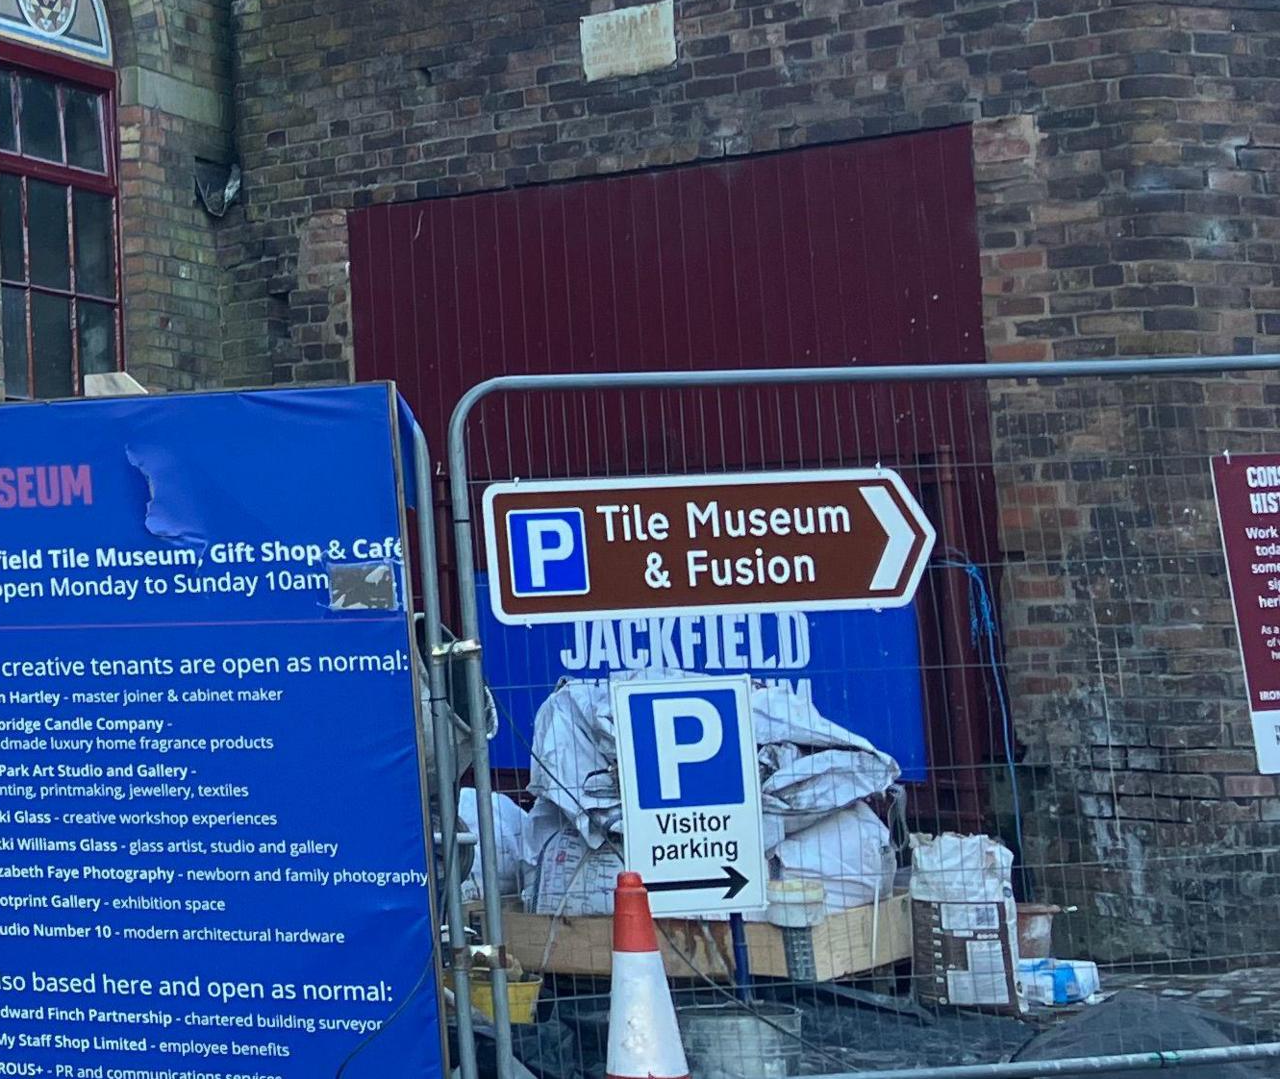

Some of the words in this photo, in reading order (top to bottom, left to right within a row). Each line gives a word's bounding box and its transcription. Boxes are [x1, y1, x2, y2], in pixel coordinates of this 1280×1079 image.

[596, 504, 670, 542] Tile
[686, 500, 850, 539] Museum
[1245, 526, 1278, 539] Work
[48, 548, 89, 568] Tile
[96, 548, 203, 567] Museum,
[211, 542, 255, 563] Gift
[261, 541, 323, 566] Shop
[326, 540, 346, 560] &
[353, 534, 403, 560] Café
[526, 519, 574, 588] P
[644, 551, 671, 589] &
[686, 548, 816, 587] Fusion
[51, 575, 138, 600] Monday
[144, 577, 167, 594] to
[174, 572, 258, 596] Sunday
[266, 571, 330, 592] 10am
[560, 612, 811, 670] JACKFIELD
[2, 657, 84, 676] creative
[90, 658, 173, 675] tenants
[180, 659, 215, 674] are
[223, 657, 279, 678] open
[287, 657, 311, 672] as
[319, 650, 408, 674] normal:
[10, 691, 60, 706] Hartley
[72, 691, 120, 702] master
[123, 690, 163, 706] joiner
[168, 689, 178, 702] &
[182, 689, 234, 701] cabinet
[238, 688, 283, 701] maker
[45, 717, 92, 730] Candle
[96, 718, 163, 733] Company
[51, 737, 93, 753] luxury
[96, 737, 136, 749] home
[140, 736, 206, 752] fragrance
[211, 736, 273, 752] products
[652, 697, 723, 799] P
[33, 765, 54, 776] Art
[58, 764, 103, 777] Studio
[107, 764, 133, 777] and
[137, 764, 187, 780] Gallery
[40, 783, 125, 800] printmaking,
[129, 784, 194, 800] jewellery,
[198, 784, 248, 796] textiles
[14, 810, 51, 823] Glass
[63, 812, 116, 824] creative
[119, 812, 188, 827] workshop
[192, 812, 277, 828] experiences
[656, 812, 730, 834] Visitor
[17, 838, 76, 851] Williams
[80, 839, 117, 851] Glass
[130, 839, 164, 855] glass
[168, 840, 207, 854] artist,
[211, 840, 254, 853] studio
[259, 840, 286, 853] and
[290, 840, 338, 857] gallery
[652, 838, 738, 866] parking
[48, 866, 79, 882] Faye
[83, 866, 174, 883] Photography
[187, 867, 250, 881] newborn
[254, 868, 281, 881] and
[286, 868, 329, 885] family
[334, 867, 430, 888] photography
[51, 895, 100, 912] Gallery
[113, 896, 181, 910] exhibition
[185, 900, 225, 913] space
[34, 924, 91, 937] Number
[95, 925, 111, 938] 10
[124, 926, 178, 939] modern
[183, 927, 271, 941] architectural
[275, 929, 344, 943] hardware
[33, 972, 95, 993] based
[103, 974, 152, 995] here
[159, 976, 200, 996] and
[208, 982, 264, 1003] open
[272, 984, 296, 999] as
[304, 981, 392, 1001] normal:
[48, 1008, 84, 1021] Finch
[89, 1009, 172, 1027] Partnership
[185, 1012, 253, 1027] chartered
[257, 1014, 315, 1032] building
[319, 1019, 382, 1034] surveyor
[19, 1034, 51, 1047] Staff
[55, 1035, 89, 1052] Shop
[94, 1037, 147, 1051] Limited
[160, 1040, 228, 1057] employee
[232, 1042, 289, 1056] benefits
[56, 1065, 73, 1077] PR
[77, 1066, 103, 1079] and
